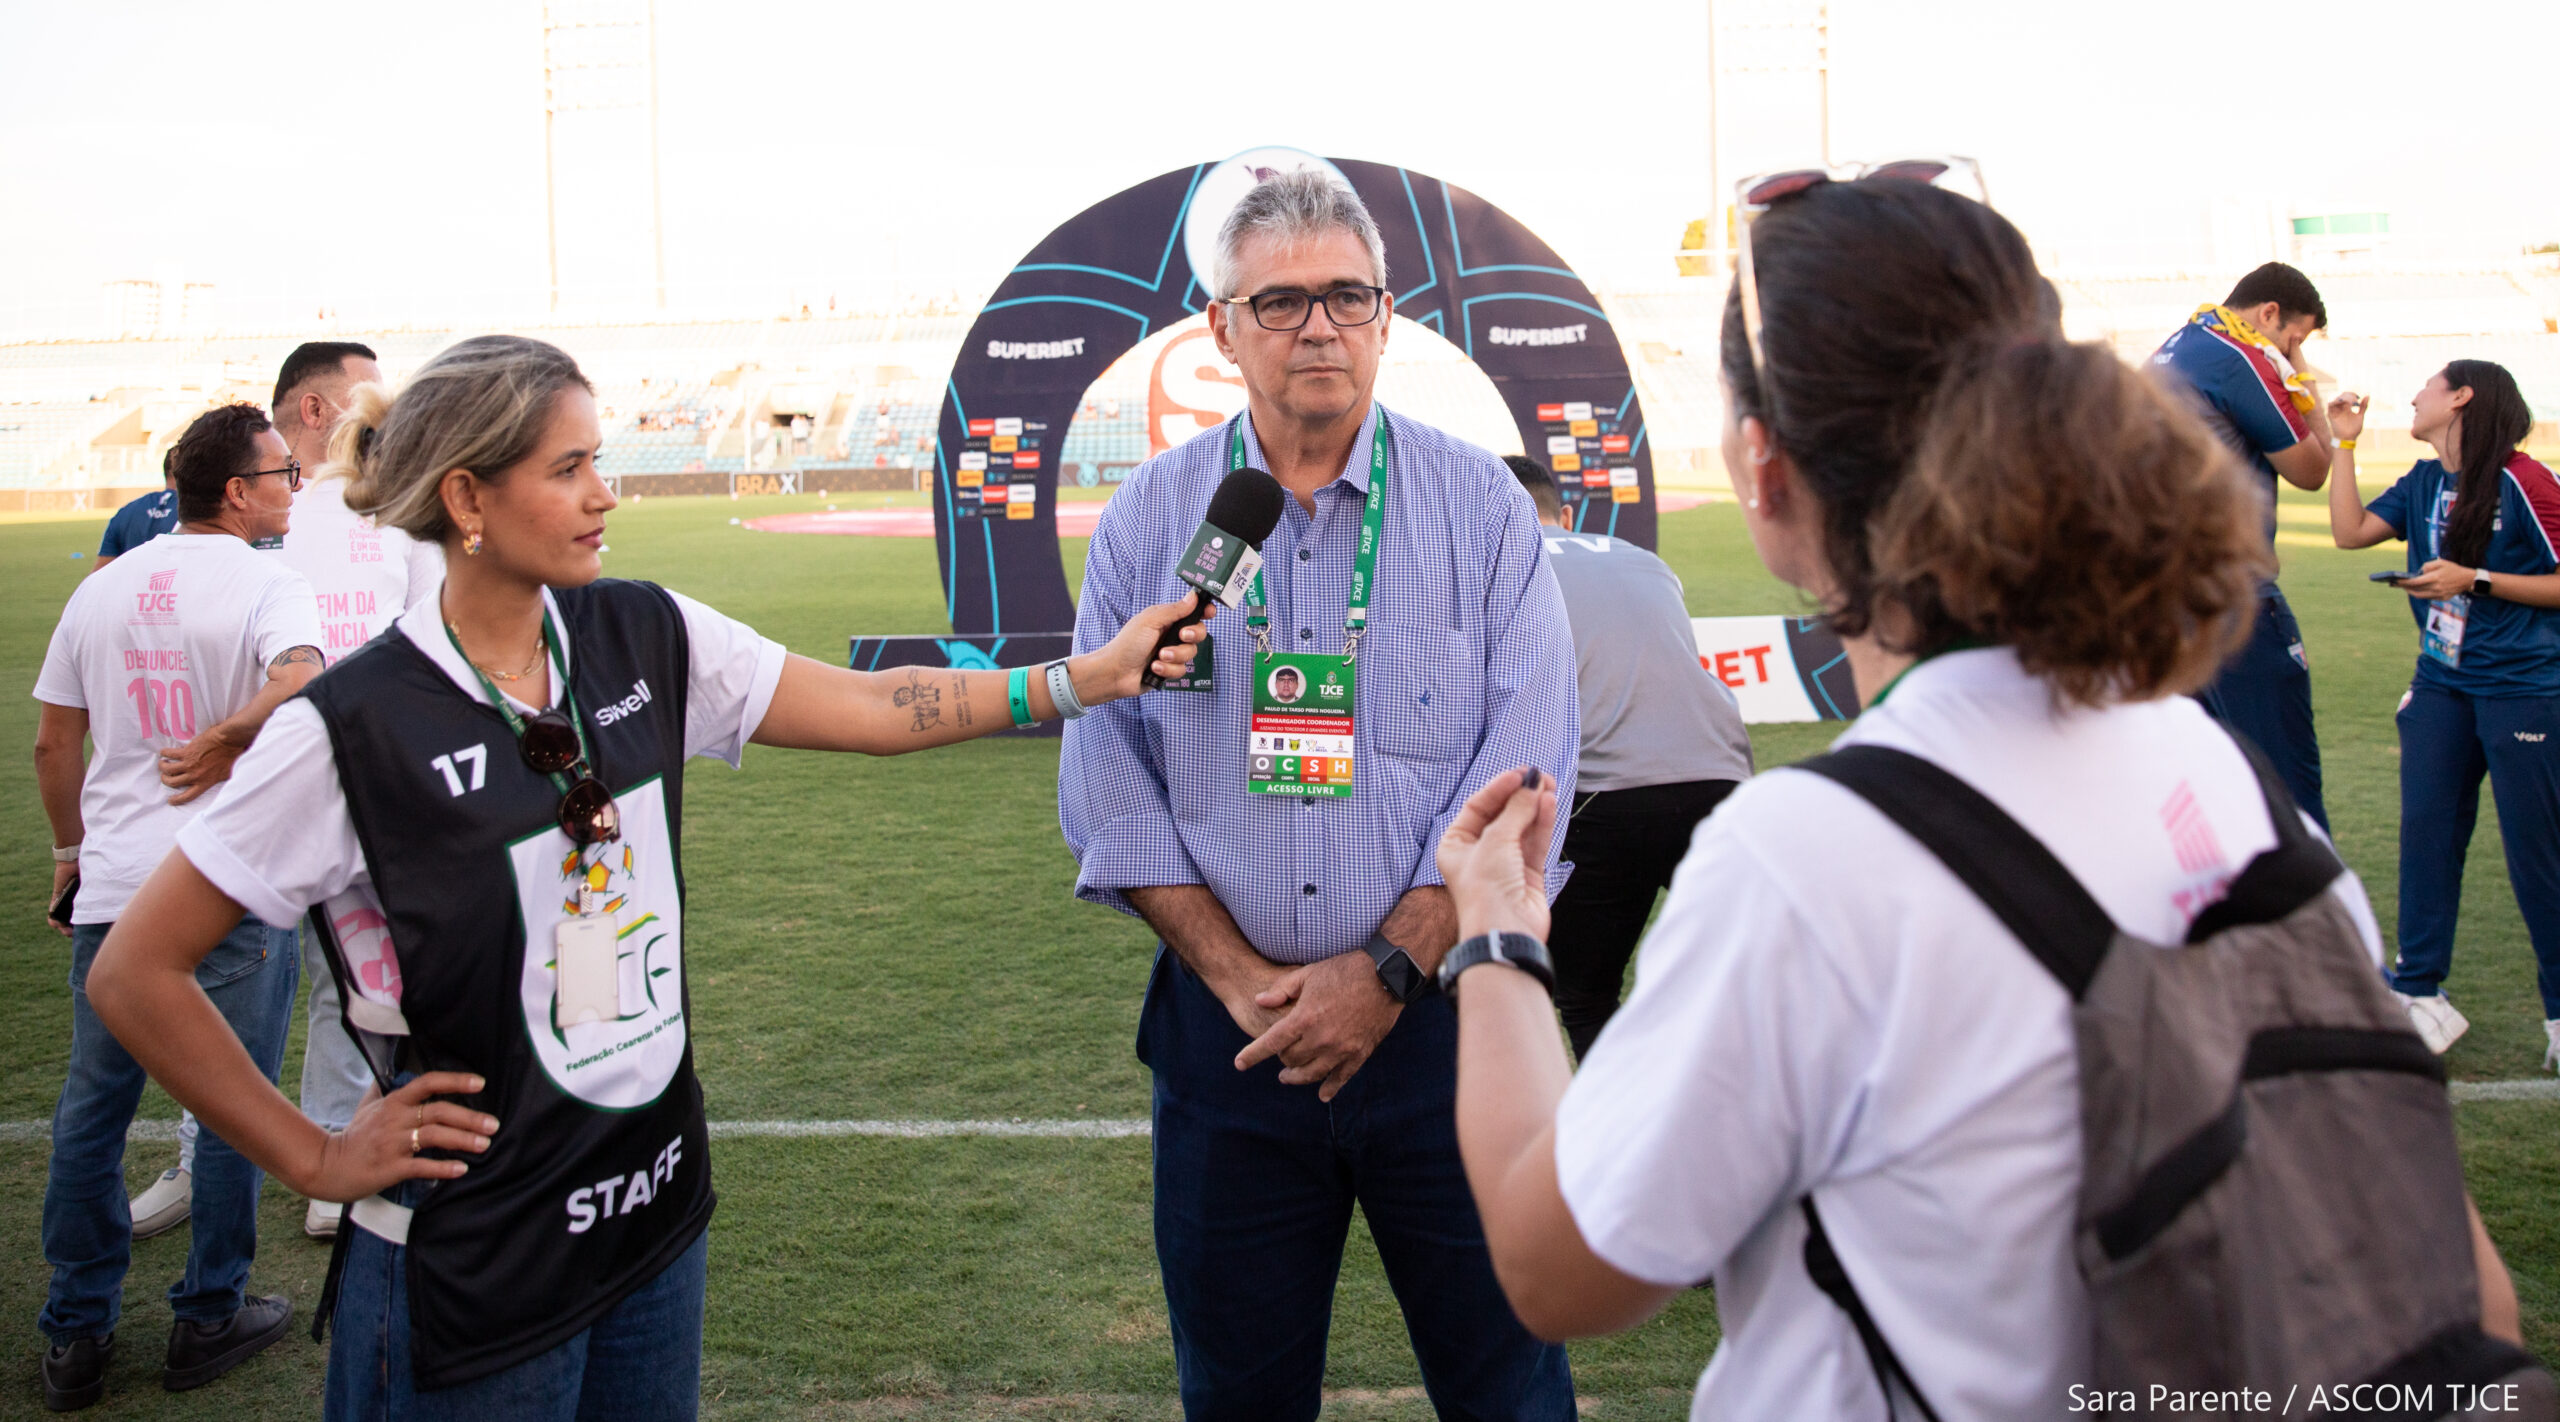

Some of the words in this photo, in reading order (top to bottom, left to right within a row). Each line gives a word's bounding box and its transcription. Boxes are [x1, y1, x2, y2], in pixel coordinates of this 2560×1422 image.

[1489, 324, 1588, 346] SUPERBET
[987, 337, 1085, 359] SUPERBET
[736, 473, 797, 495] BRAX
[1370, 491, 1380, 510] TJCE
[1361, 535, 1372, 555] TJCE
[1233, 572, 1247, 590] TJCE
[1353, 582, 1364, 602] TJCE
[137, 593, 177, 612] TJCE
[356, 591, 376, 615] DA
[1319, 684, 1344, 696] TJCE
[1256, 717, 1305, 725] DESEMBARGADOR
[431, 743, 487, 798] 17
[1255, 757, 1270, 770] O
[1282, 758, 1295, 771] C
[1309, 759, 1319, 773] S
[1334, 760, 1347, 774] H
[1266, 783, 1304, 794] ACESSO
[1307, 784, 1335, 795] LIVRE
[566, 1047, 615, 1072] Federação
[567, 1134, 682, 1234] STAFF
